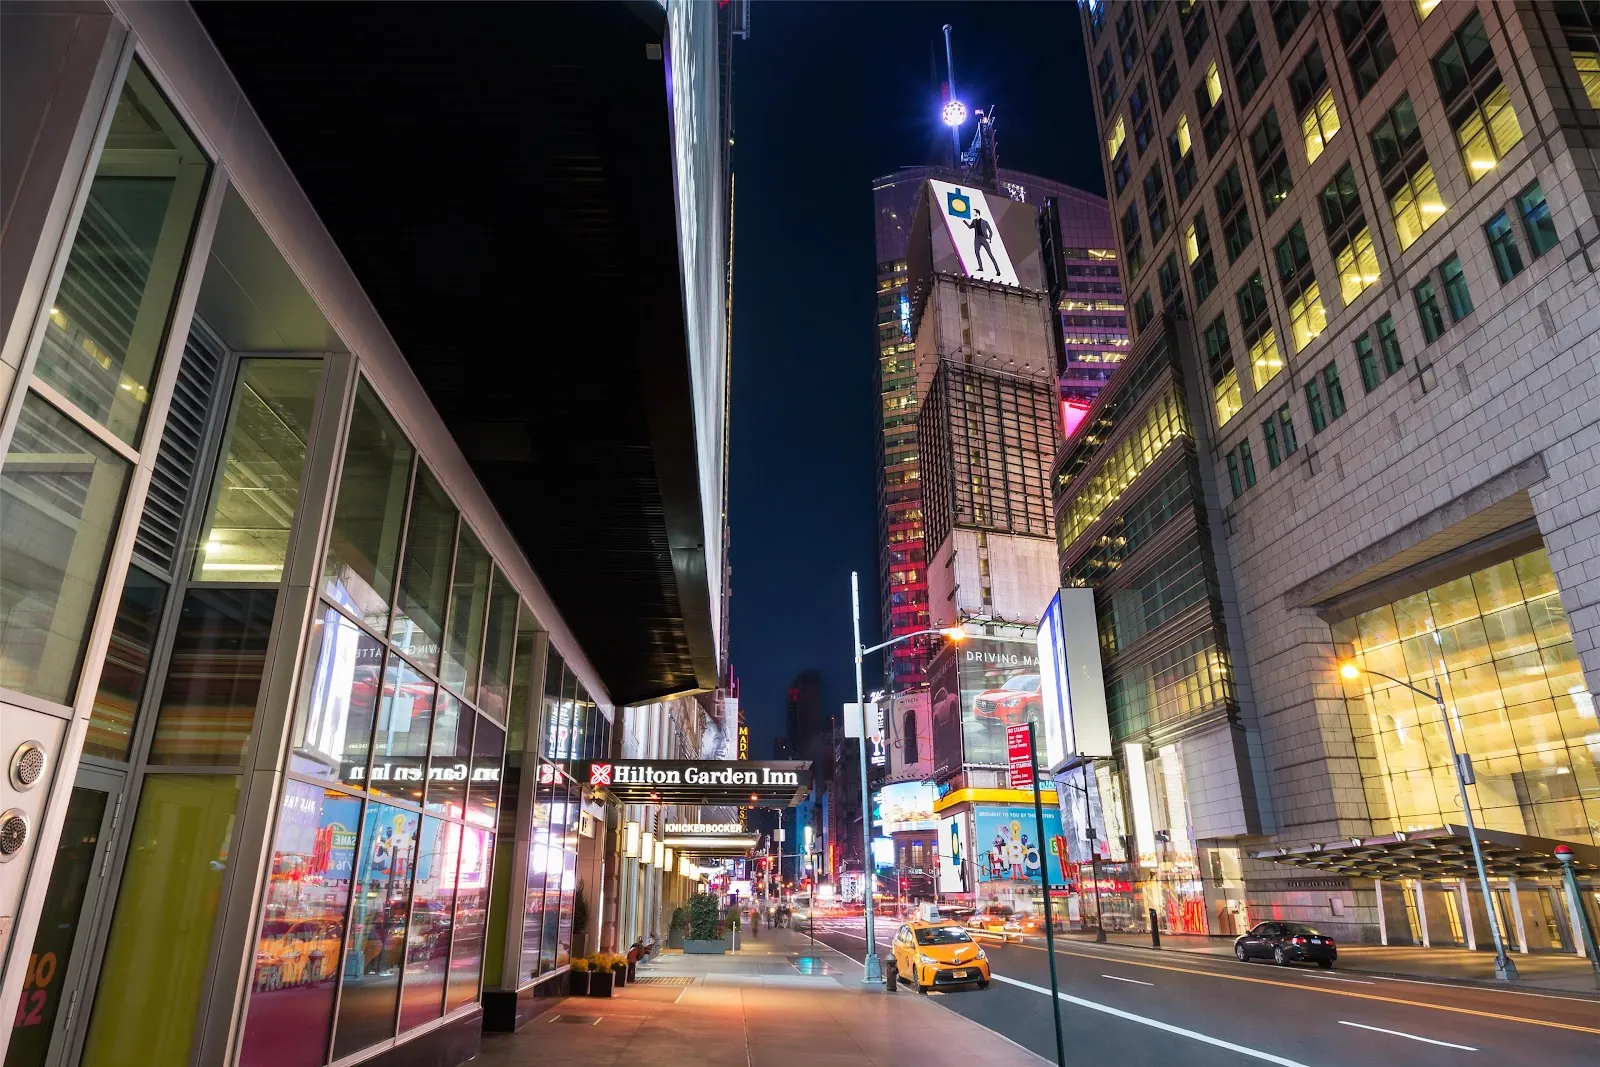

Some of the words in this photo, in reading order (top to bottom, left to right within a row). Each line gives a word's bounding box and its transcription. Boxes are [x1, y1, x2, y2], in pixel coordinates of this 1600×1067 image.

[966, 650, 1018, 665] DRIVING
[613, 765, 680, 784] Hilton
[684, 767, 758, 785] Garden
[762, 768, 798, 785] Inn
[665, 823, 742, 833] KNICKERBOCKER
